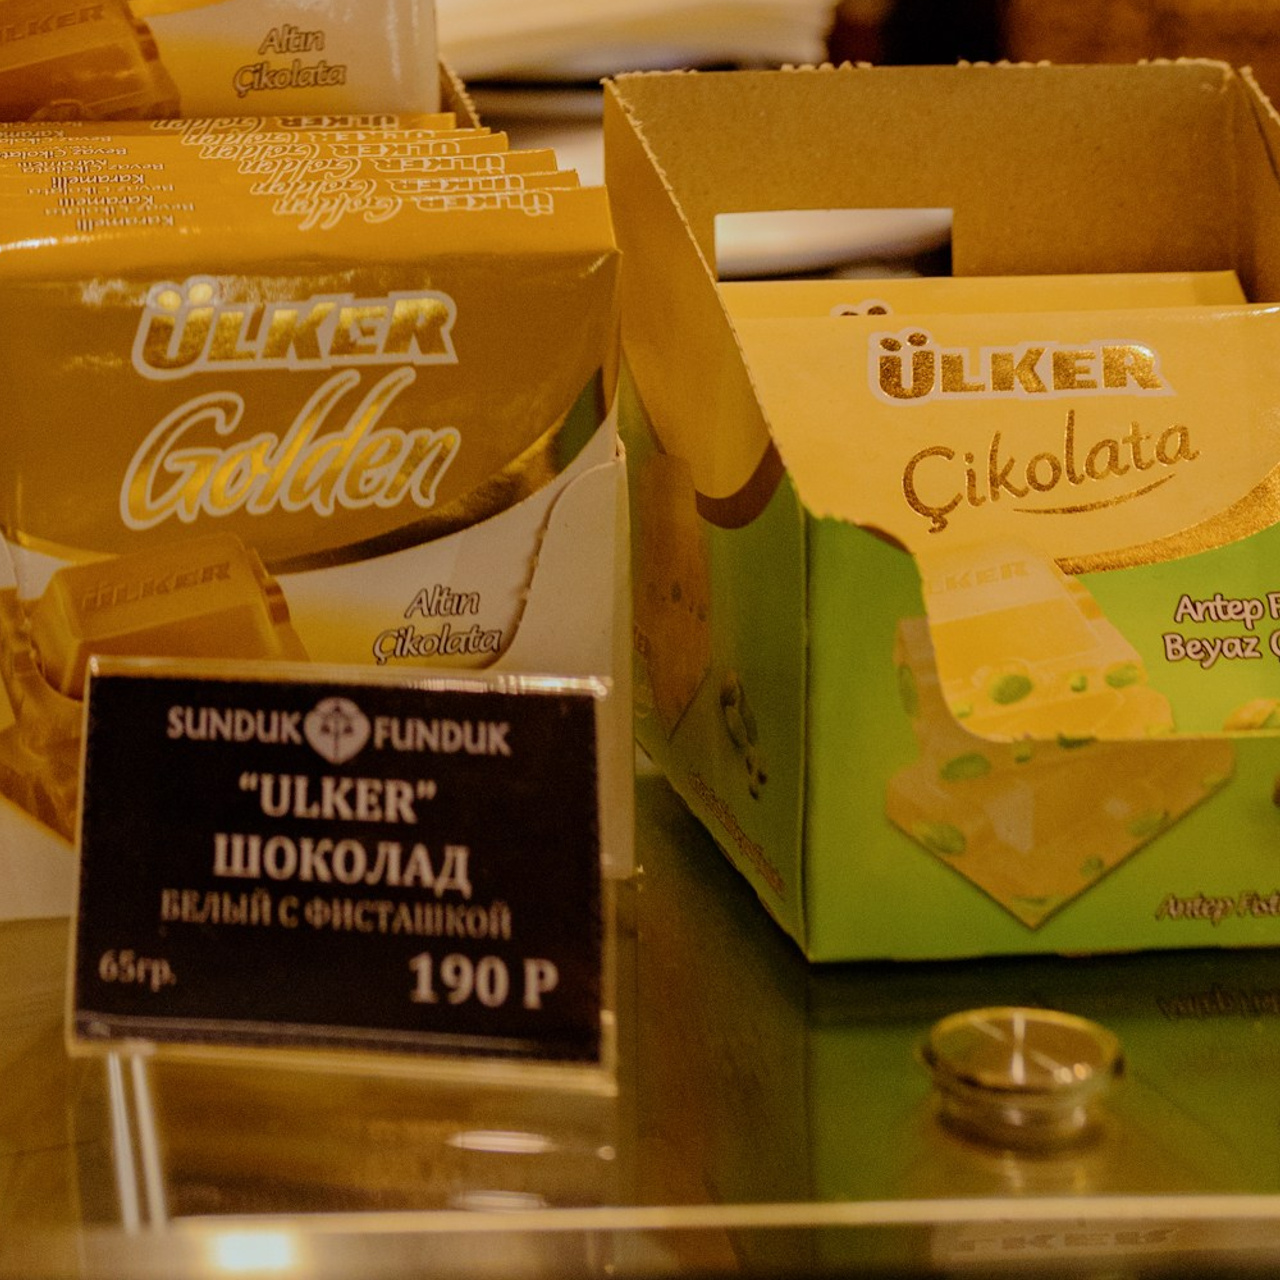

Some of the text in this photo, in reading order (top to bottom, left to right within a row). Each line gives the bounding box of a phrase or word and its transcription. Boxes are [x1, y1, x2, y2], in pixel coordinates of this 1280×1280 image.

[258, 24, 326, 55] Altın
[233, 58, 347, 98] Çikolata
[51, 174, 145, 189] Karamelli
[237, 157, 363, 183] Golden
[272, 191, 554, 232] ÜLKER Golden
[131, 275, 458, 381] ÜLKER
[868, 327, 1176, 406] ÜLKER
[120, 367, 461, 530] Golden
[903, 409, 1200, 534] Çikolata
[404, 583, 480, 619] Altın
[1174, 592, 1265, 631] Antep
[373, 625, 503, 665] Çikolata
[1162, 632, 1263, 670] Beyaz
[167, 704, 512, 758] SUNDUK FUNDUK
[212, 832, 473, 898] ШОКОЛАД
[160, 887, 273, 927] БЕЛЫЙ
[304, 896, 513, 940] ФИСТАШКОЙ
[1155, 892, 1235, 928] Antep
[408, 951, 509, 1008] 190
